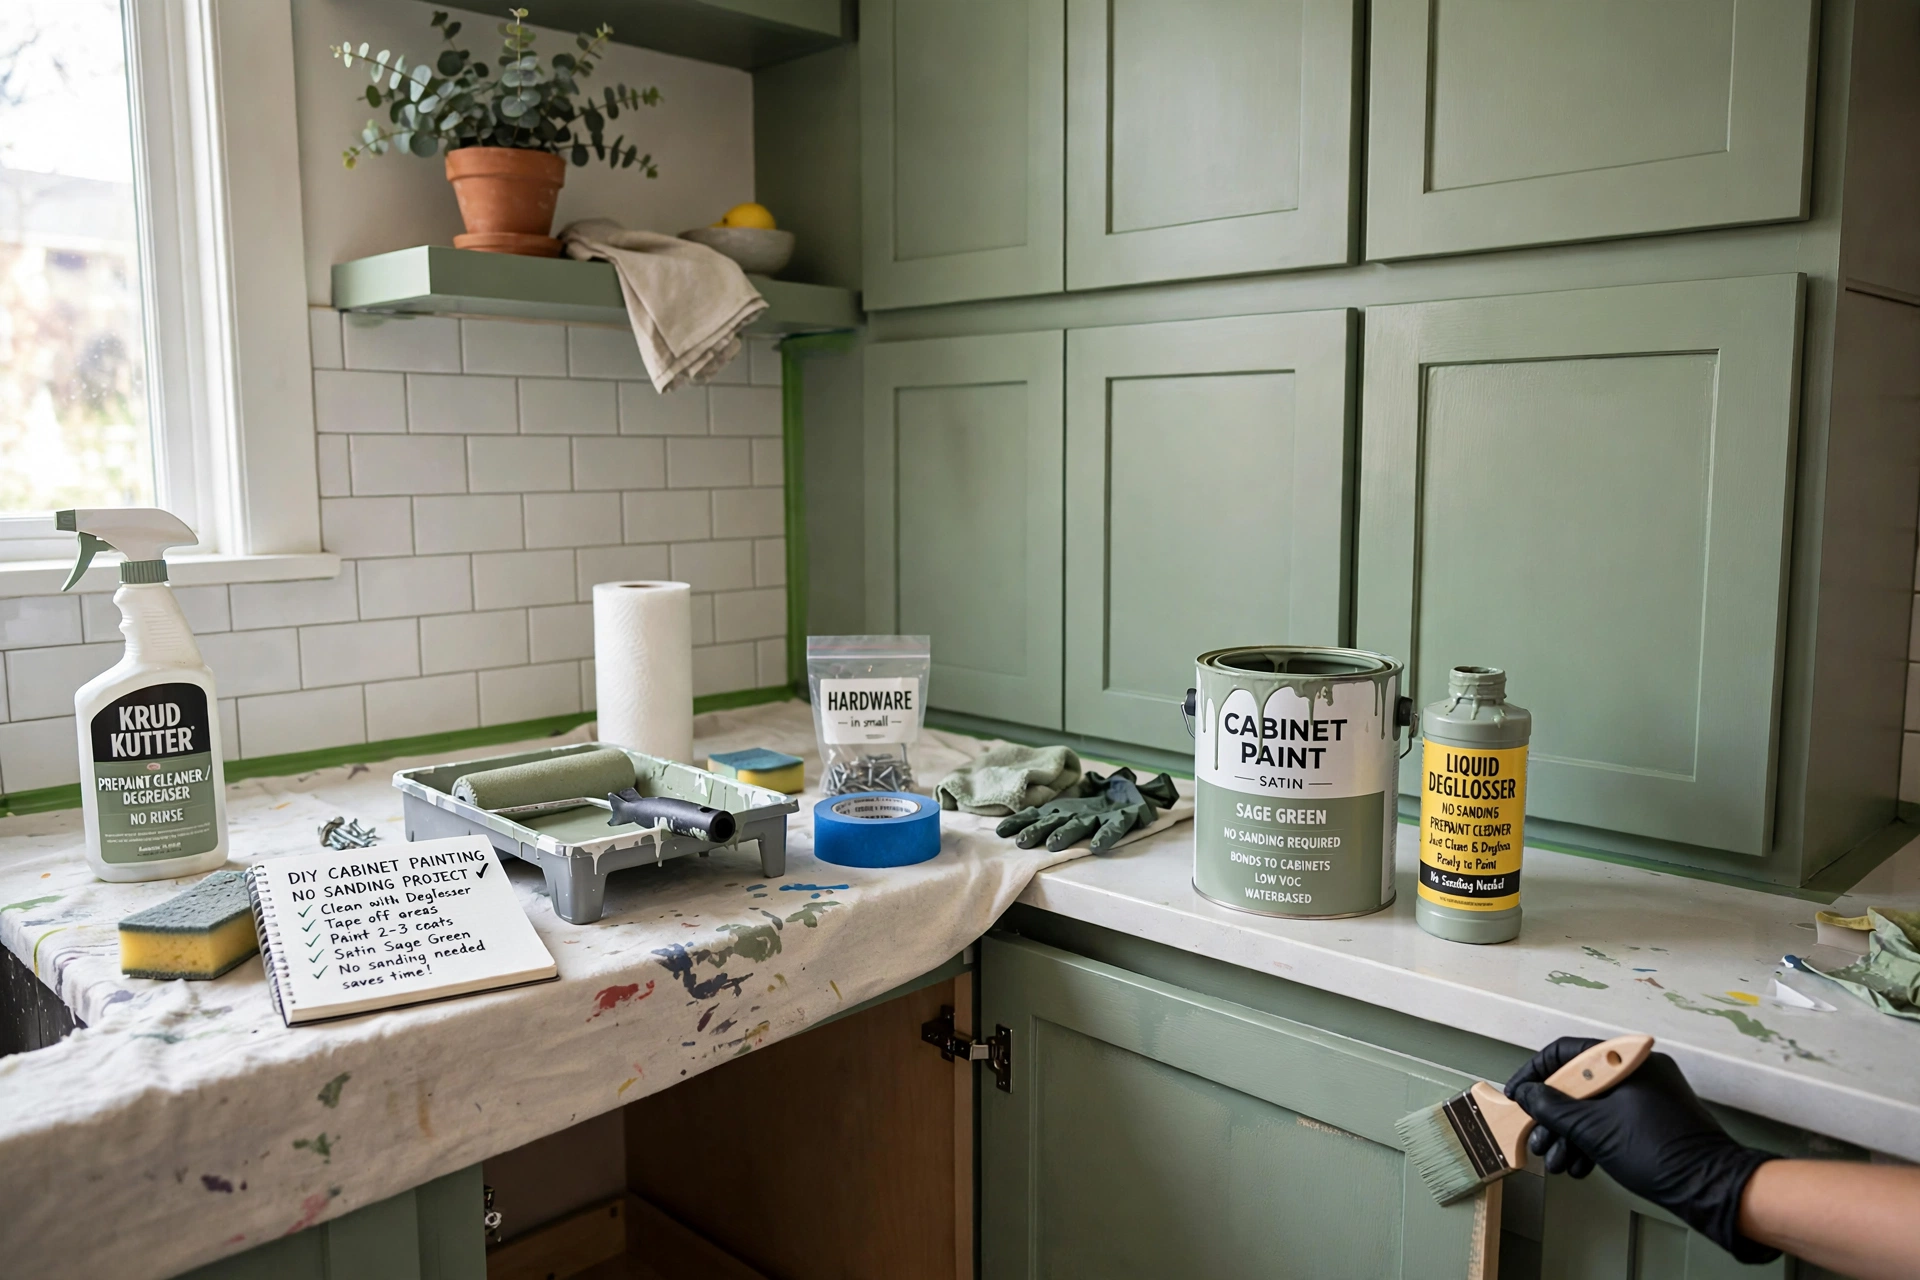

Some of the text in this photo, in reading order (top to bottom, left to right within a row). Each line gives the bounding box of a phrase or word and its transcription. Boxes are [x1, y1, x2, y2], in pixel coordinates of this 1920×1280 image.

[828, 690, 913, 711] HARDWARE
[119, 702, 181, 731] KRUD
[850, 715, 889, 728] in small
[1224, 712, 1348, 742] CABINET
[110, 727, 194, 758] KUTTER
[1241, 741, 1327, 769] PAINT
[1446, 753, 1499, 776] LIQUID
[98, 775, 151, 791] PREPAINT
[153, 768, 203, 787] CLEANER
[1259, 775, 1303, 790] SATIN
[123, 786, 191, 805] DEGREASER
[130, 808, 184, 826] NO RINSE
[1235, 802, 1327, 825] SAGE GREEN
[1442, 802, 1455, 815] NO
[1223, 826, 1341, 849] NO SANDING REQUIRED
[288, 850, 485, 885] DIY CABINET PAINTING
[1230, 851, 1331, 871] BONDS TO CABINETS
[292, 868, 468, 902] NO SANDING PROJECT
[1254, 873, 1302, 887] LOW VOC
[320, 902, 363, 915] Clean
[369, 895, 400, 907] with
[1244, 887, 1312, 904] WATERBASED
[324, 905, 438, 931] Tape off areas
[330, 929, 370, 945] Paint
[378, 923, 408, 938] 2-3
[334, 931, 471, 960] Satin Sage Green
[338, 939, 486, 975] No sanding needed
[342, 963, 433, 990] saves time!
